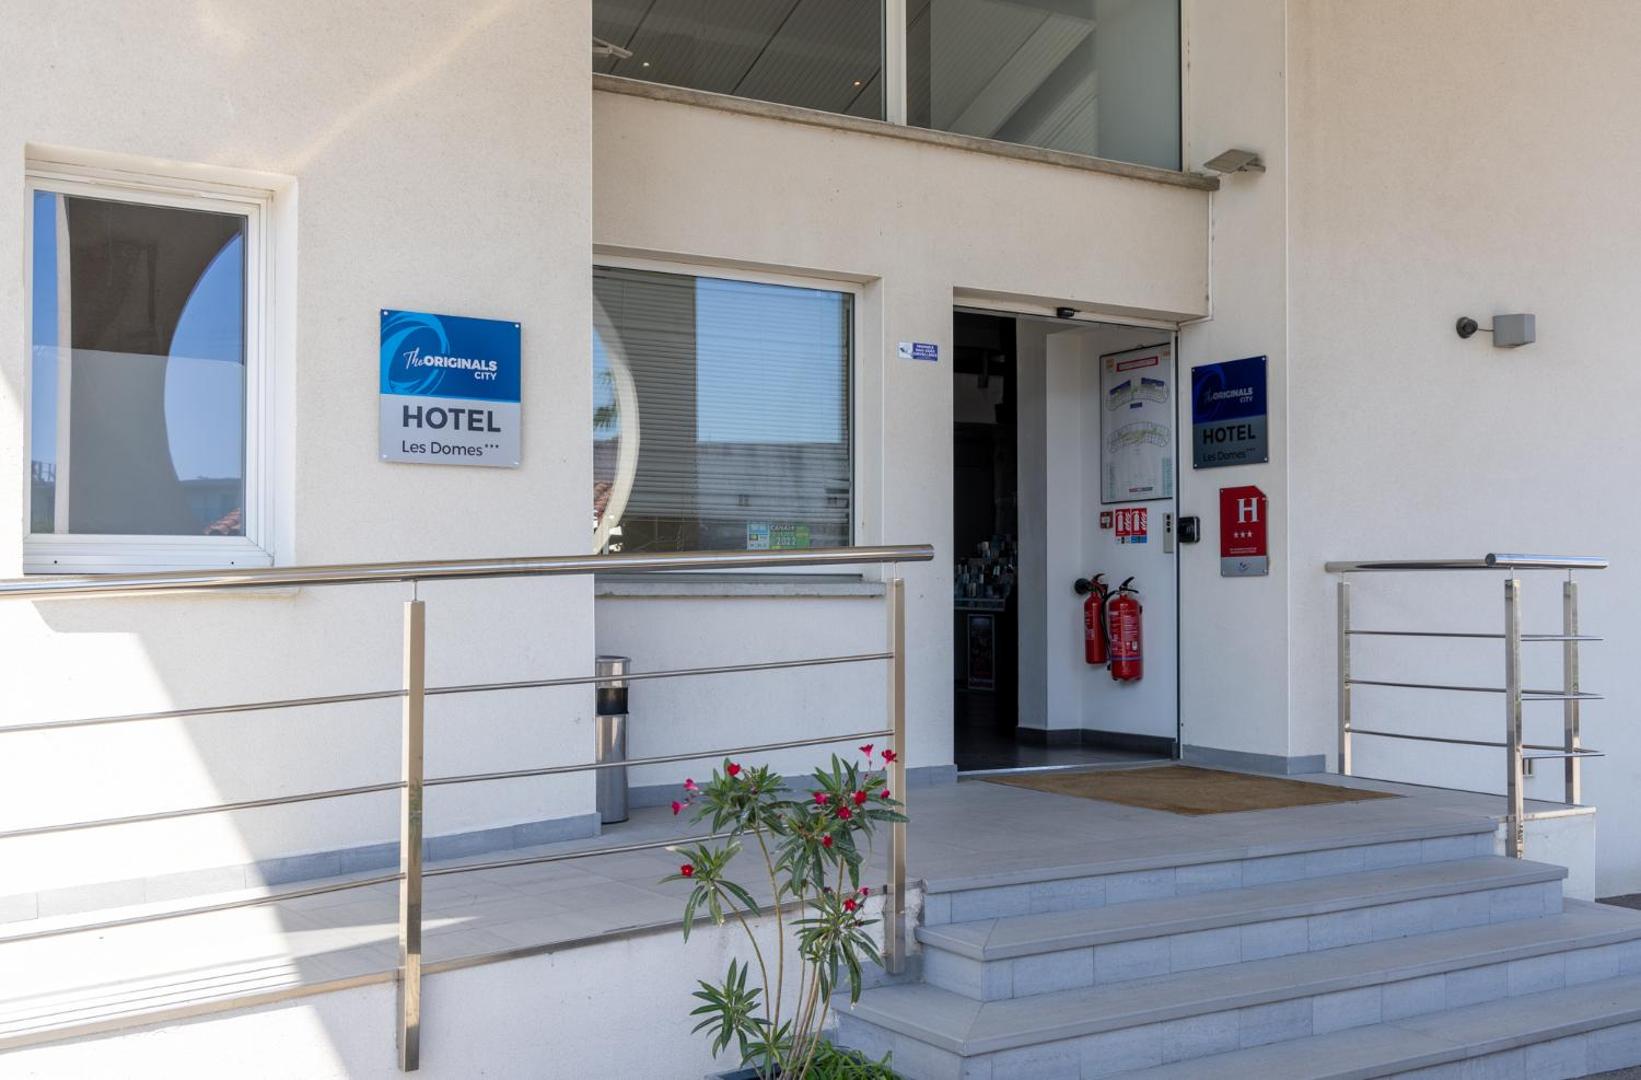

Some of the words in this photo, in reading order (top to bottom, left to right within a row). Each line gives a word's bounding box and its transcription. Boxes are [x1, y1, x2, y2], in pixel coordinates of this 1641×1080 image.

[403, 347, 425, 370] The
[424, 355, 497, 371] ORIGINALS
[474, 371, 497, 380] CITY
[402, 405, 501, 432] HOTEL
[1203, 424, 1256, 445] HOTEL
[402, 440, 426, 453] Les
[1237, 497, 1259, 523] H
